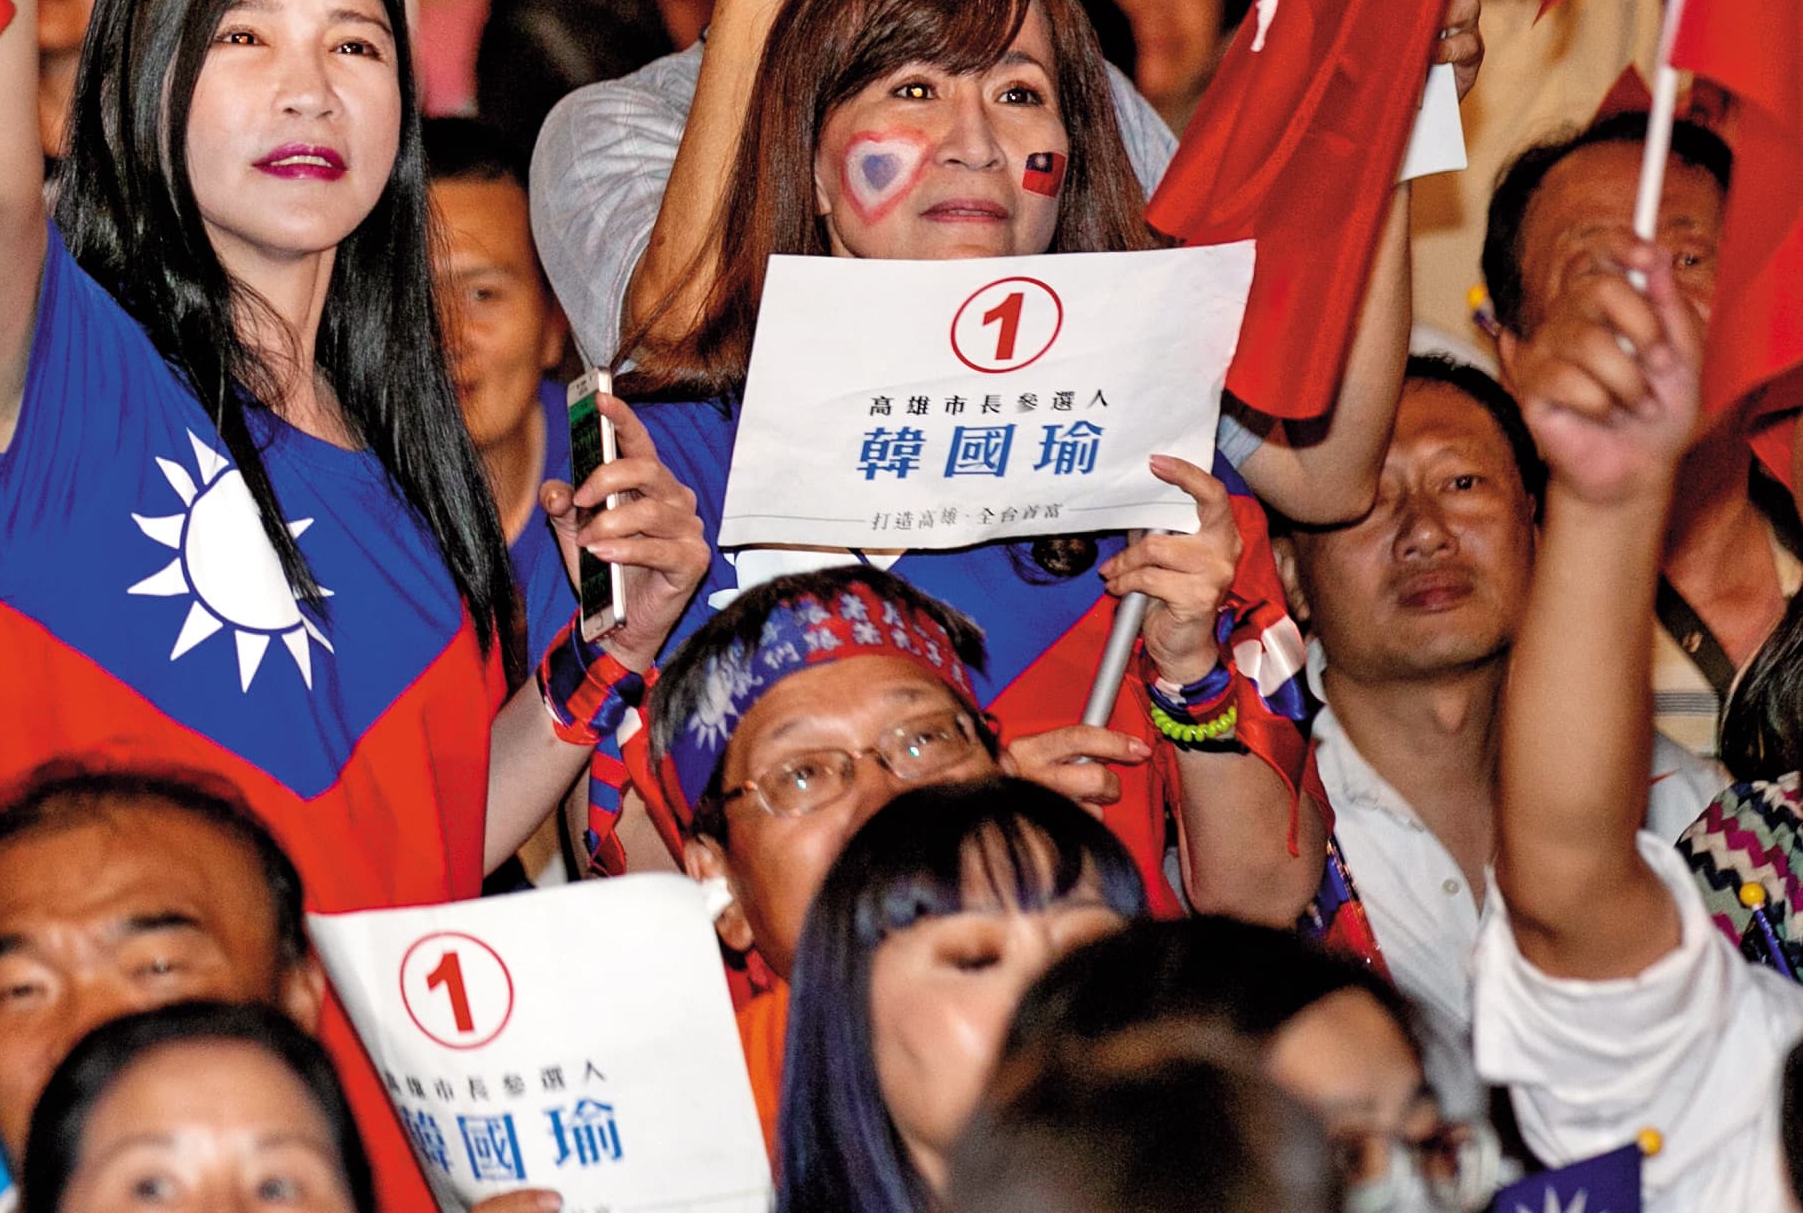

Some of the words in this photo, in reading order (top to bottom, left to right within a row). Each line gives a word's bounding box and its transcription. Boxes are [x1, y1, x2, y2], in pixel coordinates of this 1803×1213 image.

[981, 292, 1024, 361] 1
[868, 389, 1110, 418] 高雄市長參選人
[855, 420, 1107, 481] 韓國瑜
[426, 950, 474, 1033] 1
[399, 1098, 624, 1181] 韓國瑜
